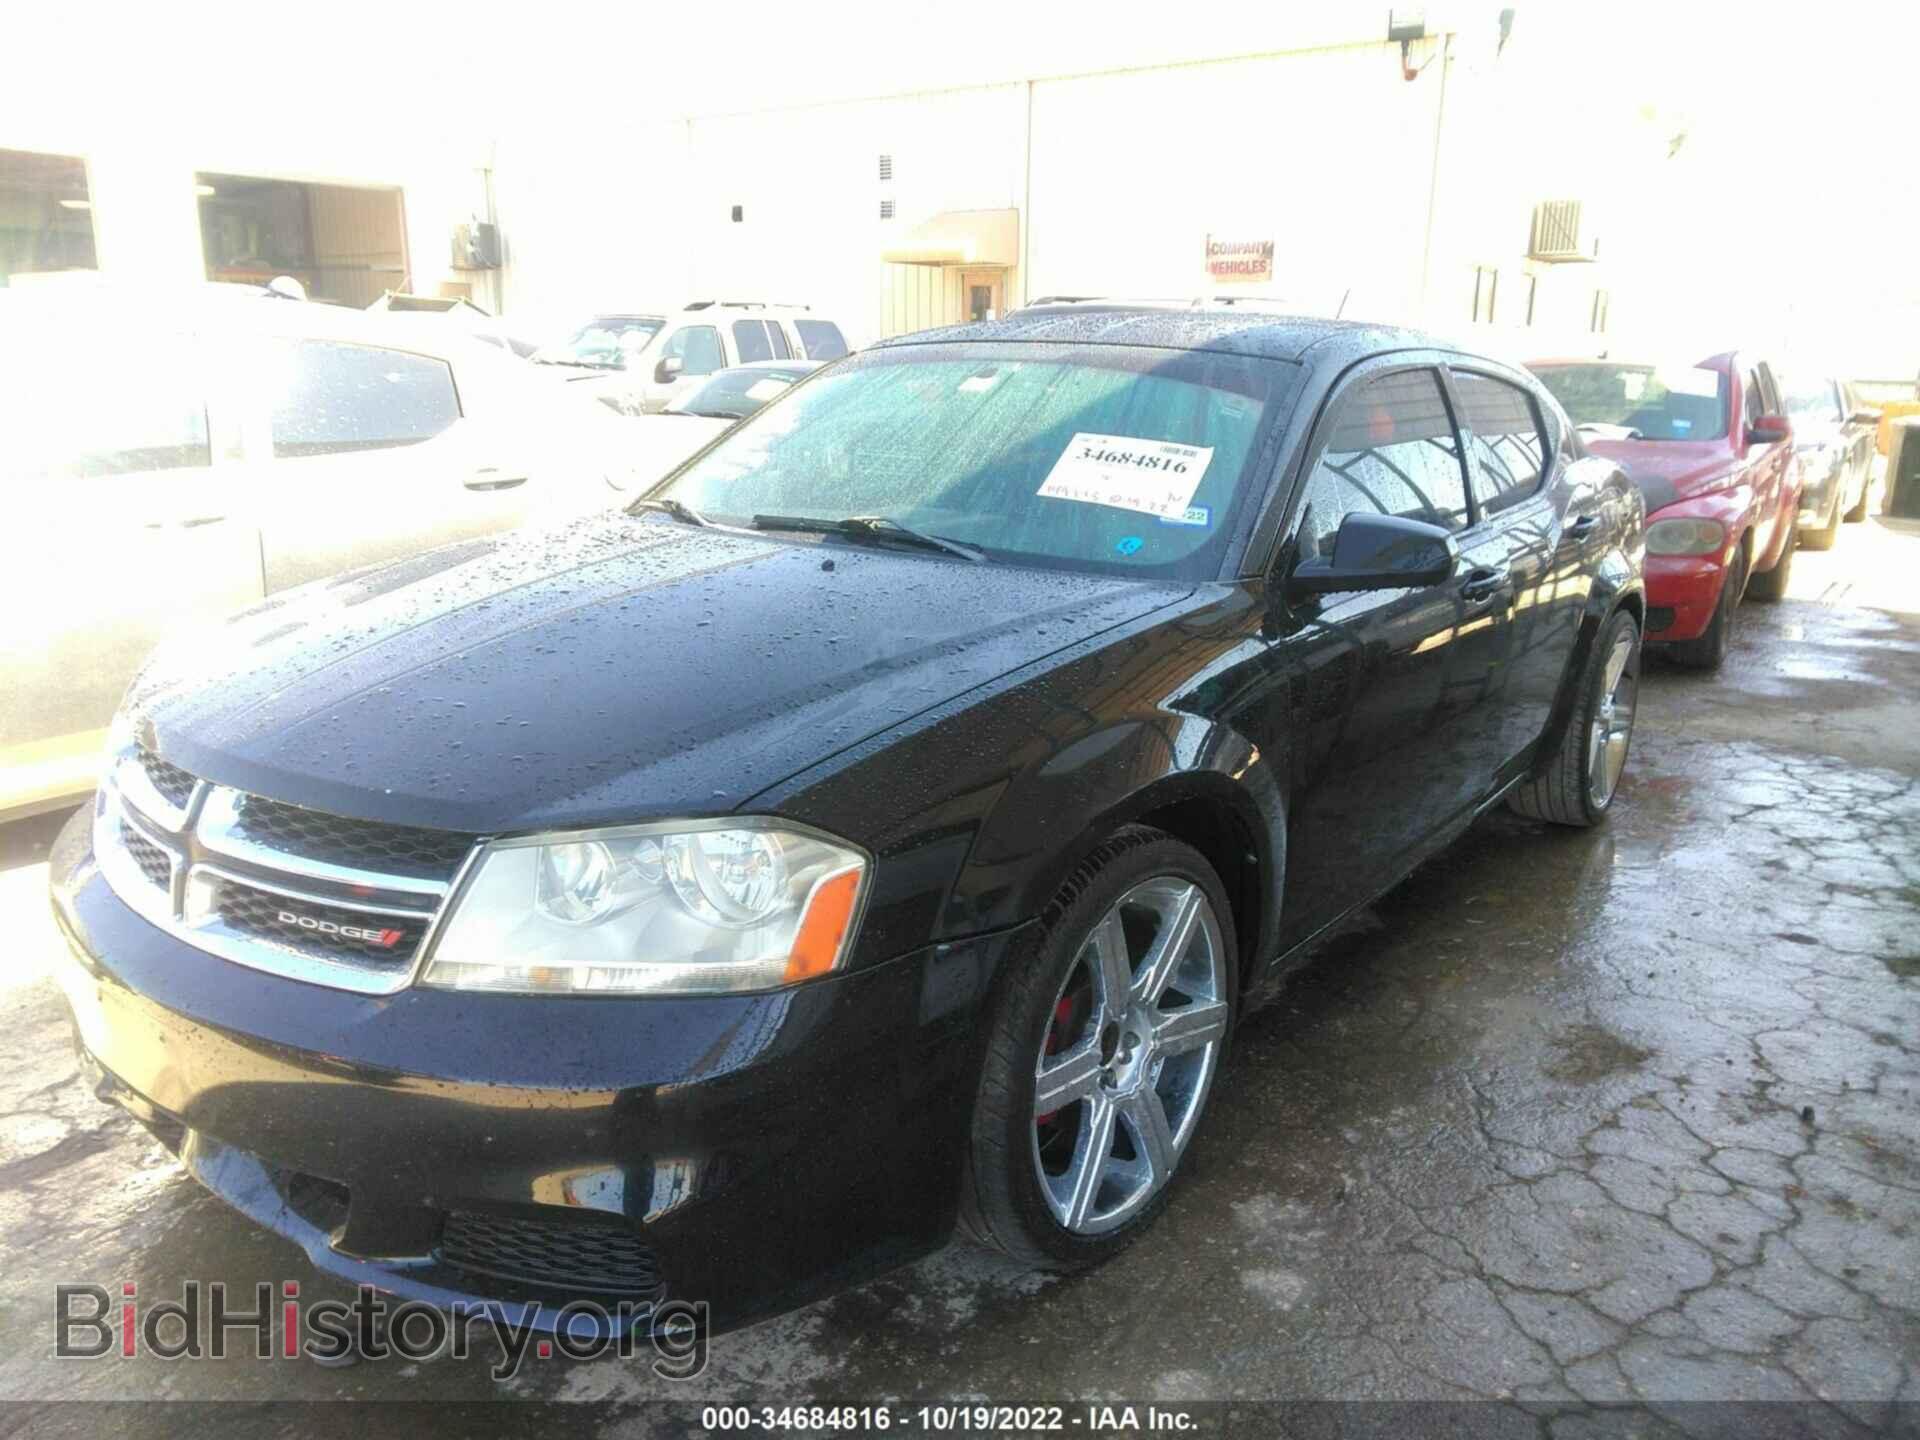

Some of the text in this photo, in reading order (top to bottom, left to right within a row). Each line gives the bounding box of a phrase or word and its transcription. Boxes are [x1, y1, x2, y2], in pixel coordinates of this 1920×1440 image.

[1211, 240, 1267, 256] COMPANY
[1211, 259, 1266, 274] VEHICLES
[1076, 447, 1188, 474] 34684816
[277, 911, 384, 943] DODGE
